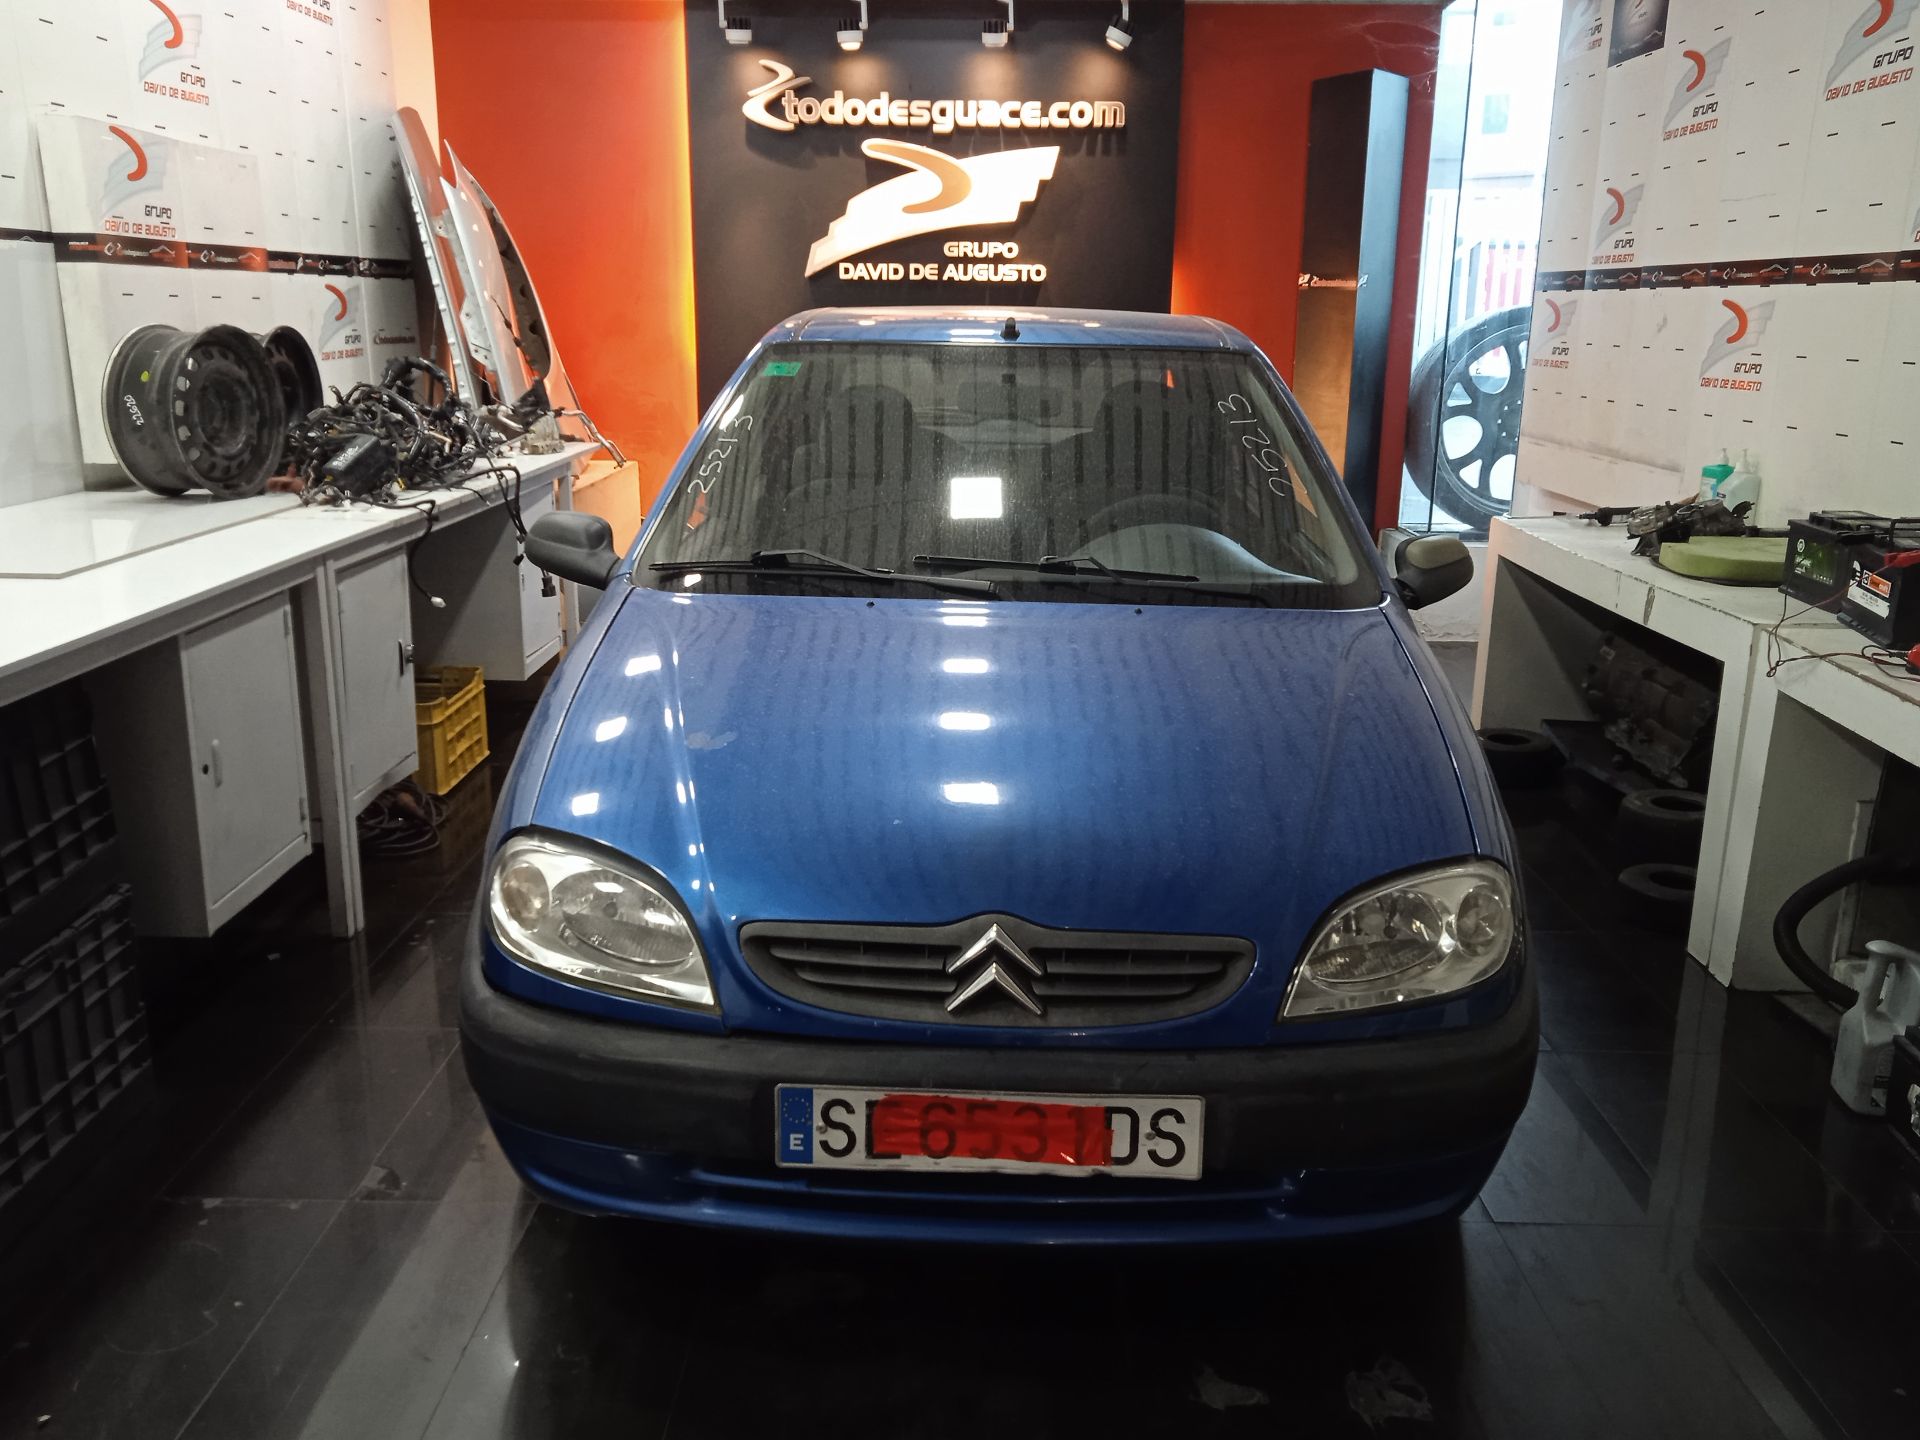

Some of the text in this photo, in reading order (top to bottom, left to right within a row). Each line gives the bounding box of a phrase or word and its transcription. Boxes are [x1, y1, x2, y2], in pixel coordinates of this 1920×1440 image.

[782, 89, 1125, 134] tododesguace.com
[943, 241, 1019, 259] GRUPO
[838, 262, 1047, 282] DAVID DE AUGUSTO
[788, 1133, 805, 1151] E
[1103, 1105, 1188, 1169] DS
